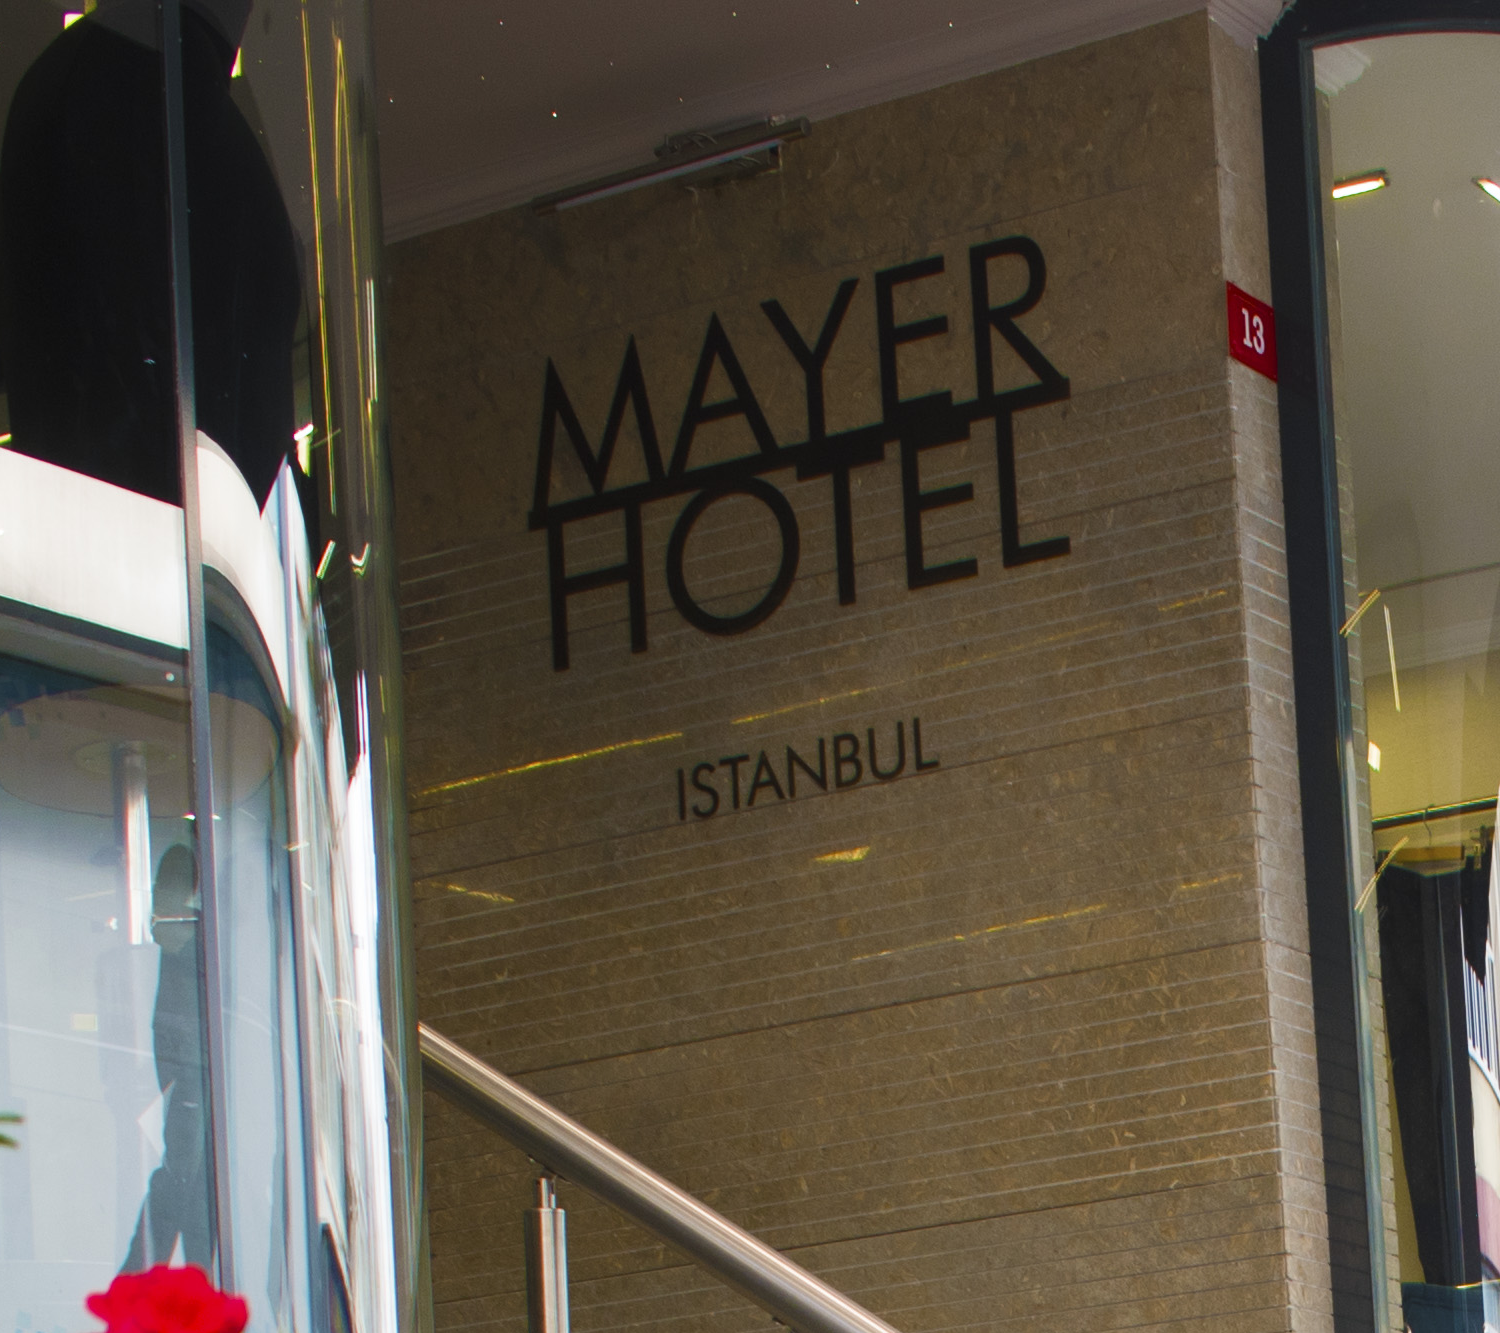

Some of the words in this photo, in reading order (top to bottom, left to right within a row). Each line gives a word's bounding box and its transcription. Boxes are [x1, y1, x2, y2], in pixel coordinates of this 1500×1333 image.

[528, 236, 1070, 530] MAYER
[1242, 307, 1265, 355] 13
[545, 395, 1071, 672] HOTEL
[674, 717, 940, 822] ISTANBUL
